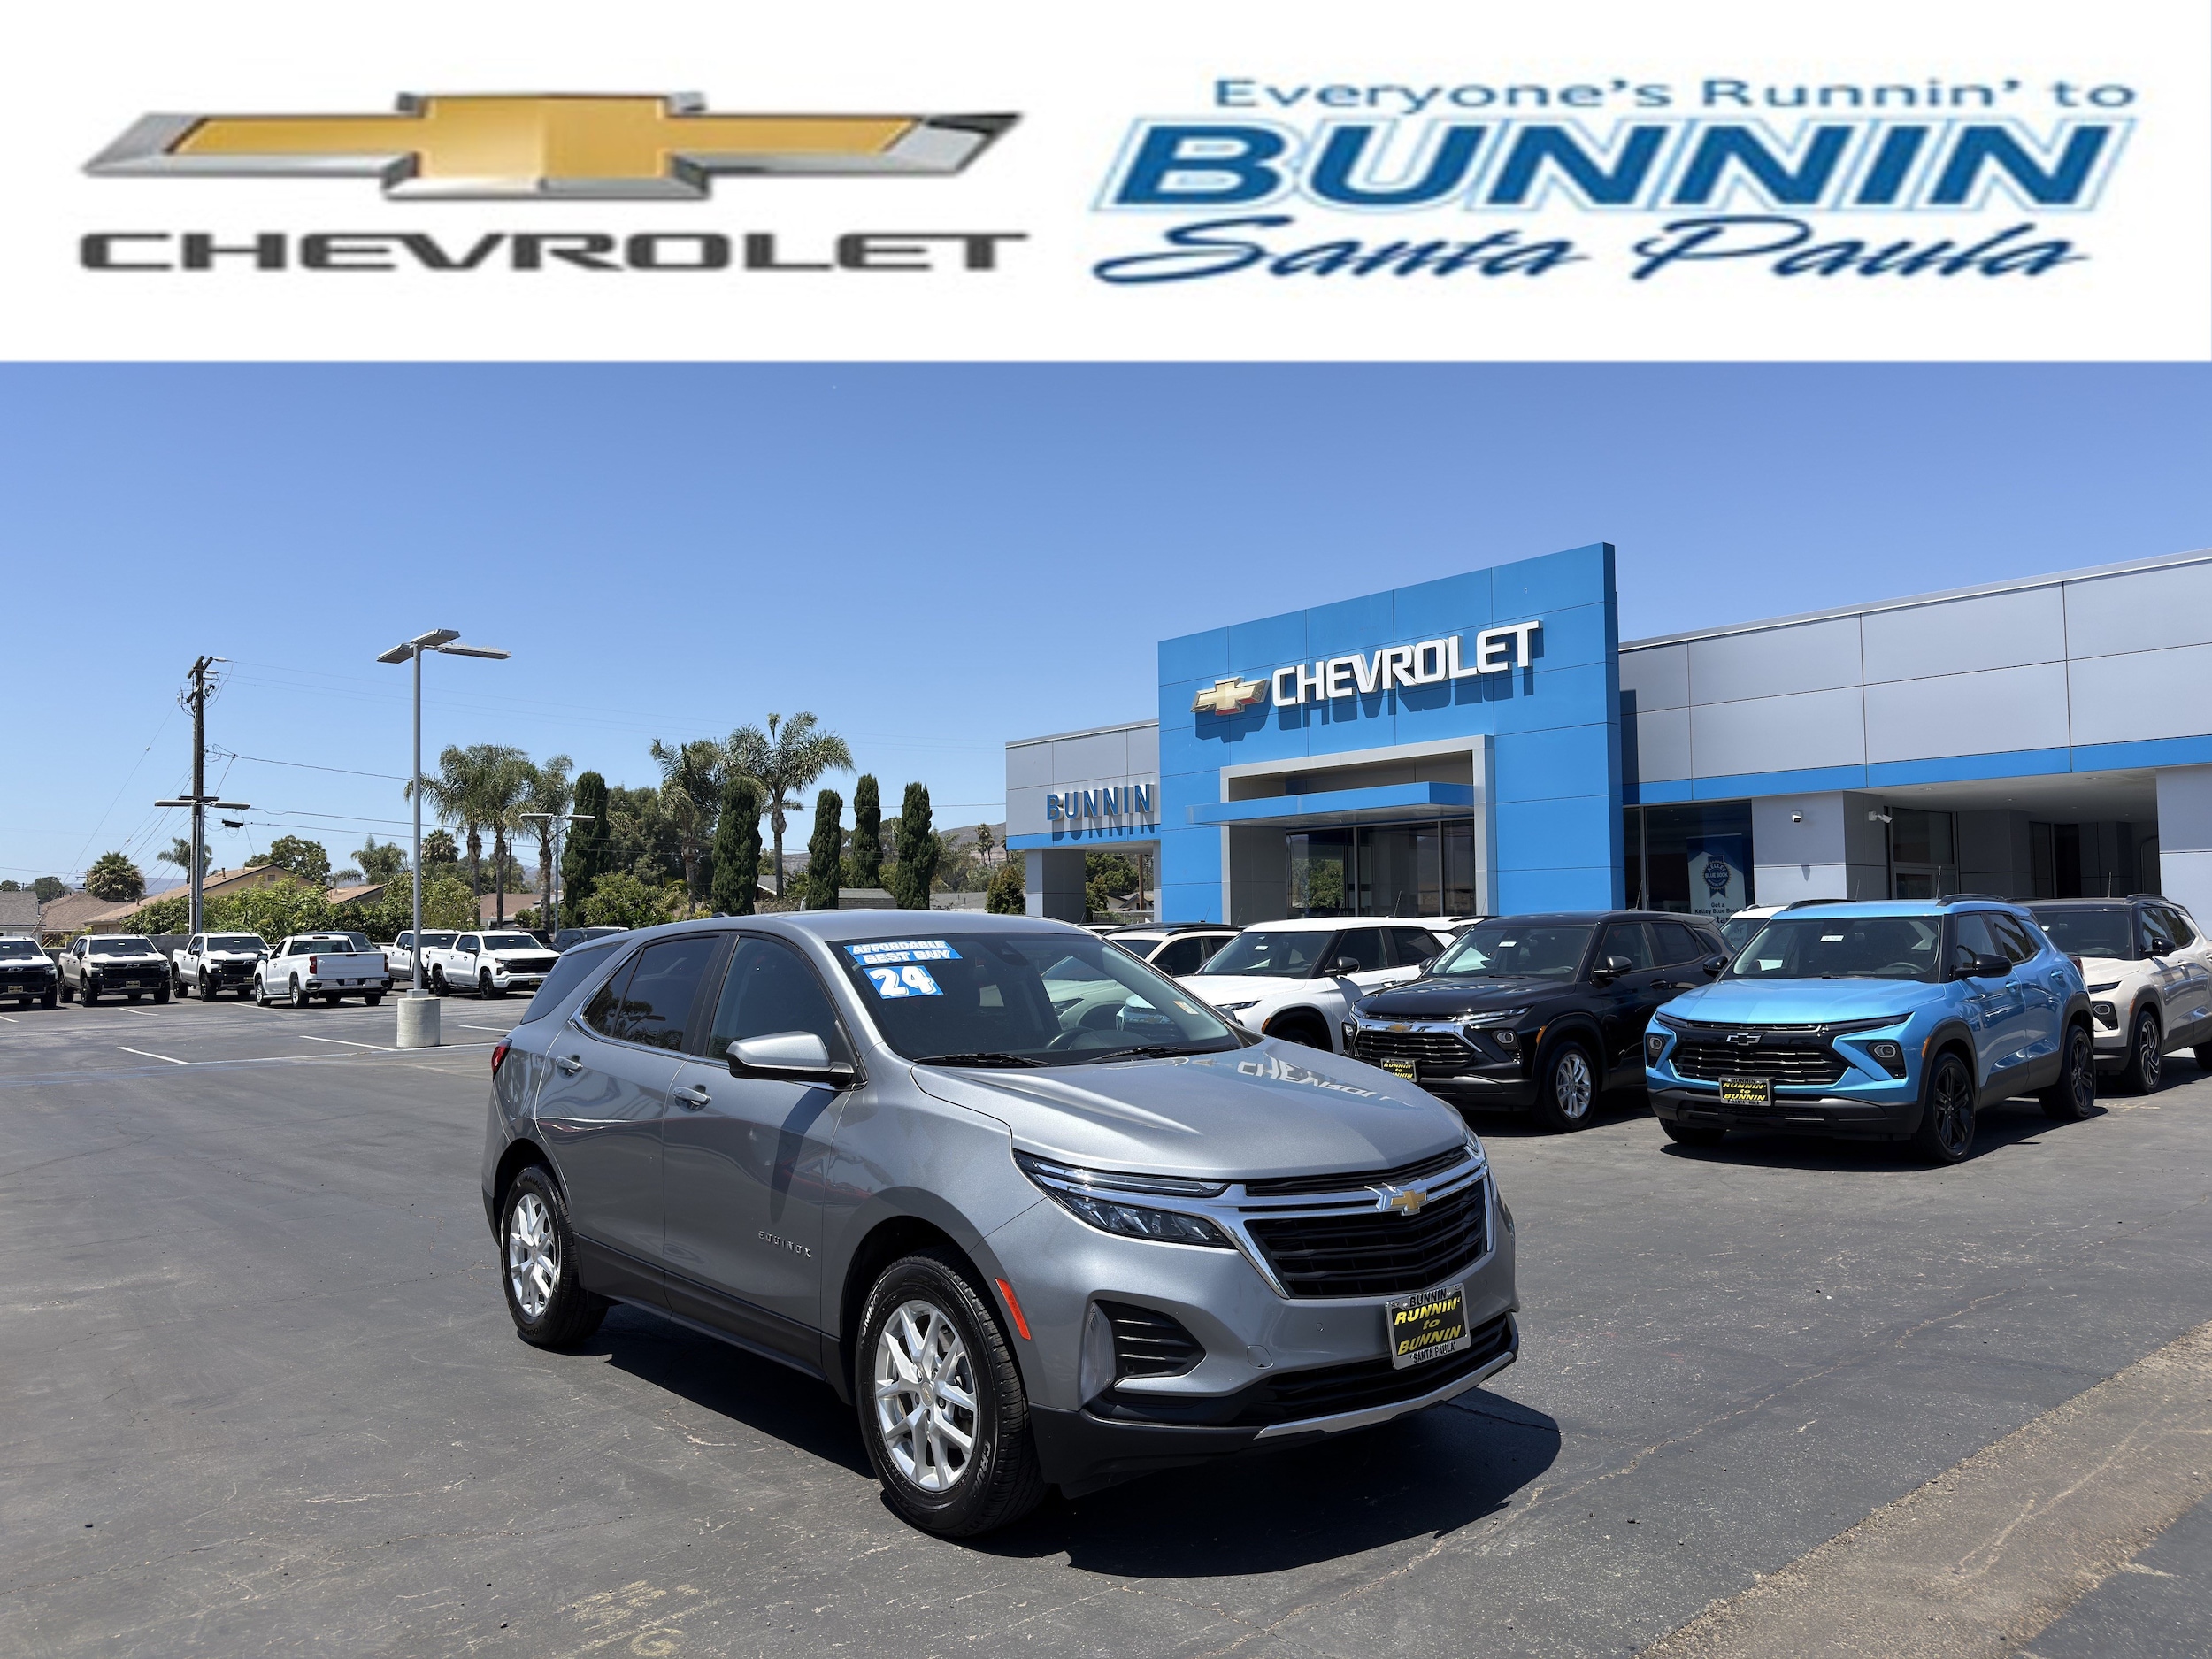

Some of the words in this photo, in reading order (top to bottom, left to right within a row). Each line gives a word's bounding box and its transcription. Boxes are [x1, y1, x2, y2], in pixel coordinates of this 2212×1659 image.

[1272, 619, 1542, 707] CHEVROLET
[1047, 784, 1153, 821] BUNNIN
[852, 940, 948, 954] AFFORDABLE
[863, 951, 910, 964] BEST
[913, 949, 950, 960] BUY
[869, 965, 937, 997] 24
[757, 1230, 811, 1258] EQUINOX
[1394, 1296, 1462, 1325] RUNNIN'
[1409, 1288, 1448, 1307] BUNNIN
[1422, 1318, 1440, 1330] to
[1397, 1325, 1462, 1356] BUNNIN
